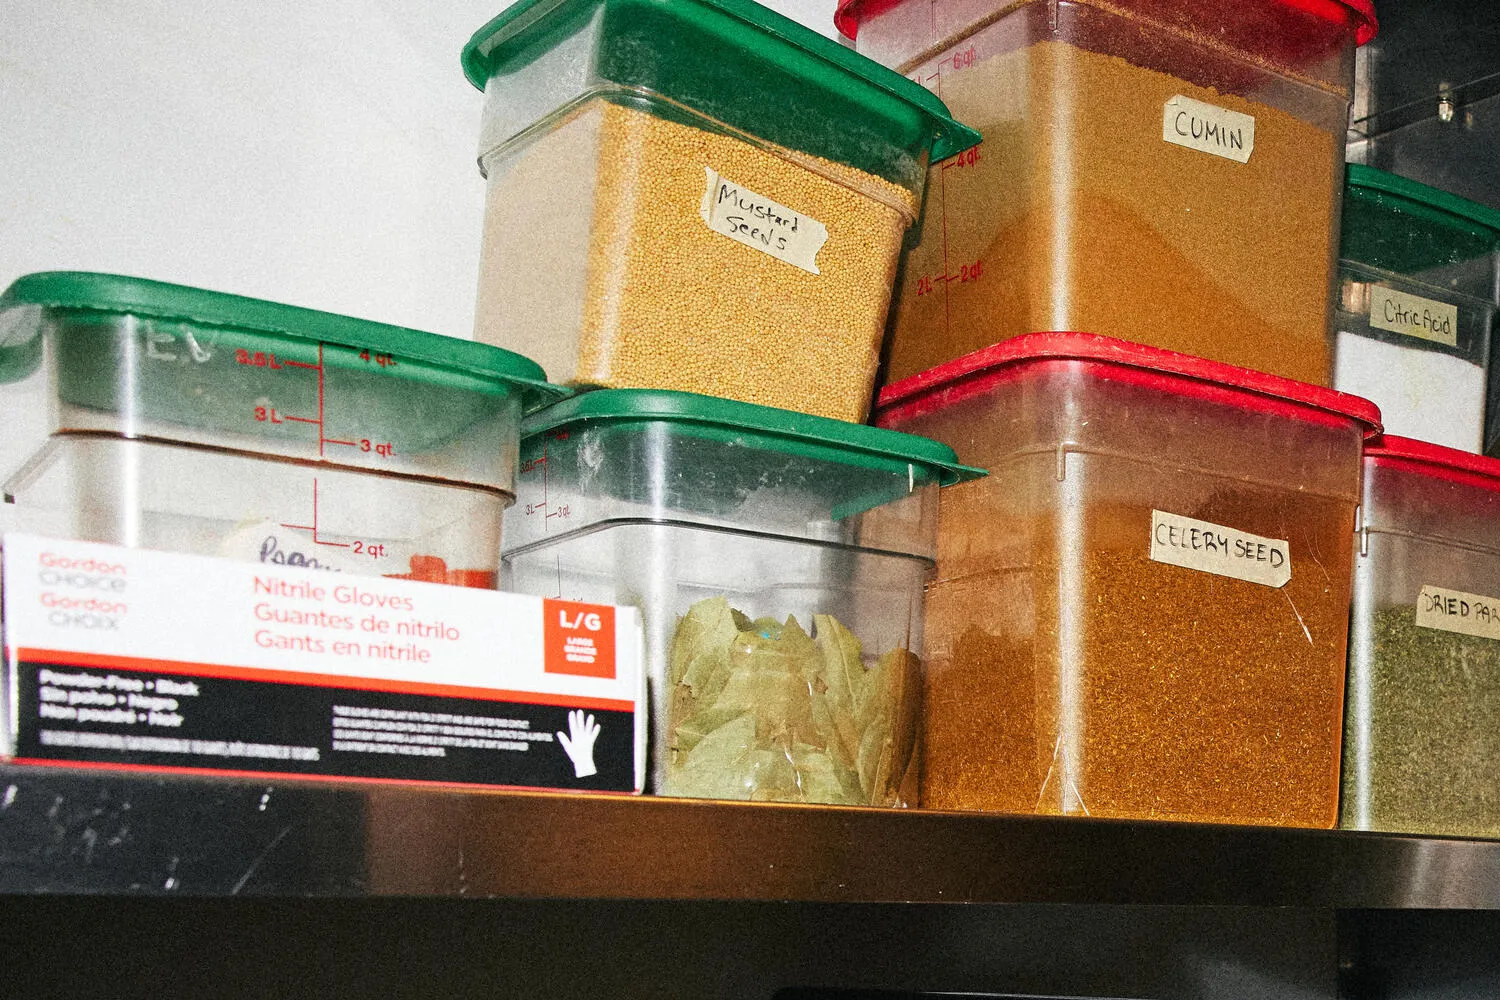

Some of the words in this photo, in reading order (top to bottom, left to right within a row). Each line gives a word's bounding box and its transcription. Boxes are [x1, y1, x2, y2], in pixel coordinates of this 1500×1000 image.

[1175, 111, 1243, 150] CUMIN
[718, 184, 798, 233] Mustard
[1384, 299, 1420, 326] Citric
[1423, 309, 1452, 335] Acid
[360, 439, 371, 452] 3
[353, 540, 364, 554] 2
[367, 544, 390, 559] qt.
[1156, 523, 1228, 556] CELERY
[1234, 539, 1285, 569] SEED
[254, 575, 326, 601] Nitrile
[333, 585, 415, 611] Gloves
[1424, 593, 1470, 617] DRIED
[254, 602, 354, 631] Guantes
[360, 615, 390, 634] de
[397, 618, 461, 641] nitrilo
[560, 609, 601, 631] L/G
[254, 629, 325, 653] Gants
[332, 639, 361, 657] en
[368, 641, 431, 663] nitrile
